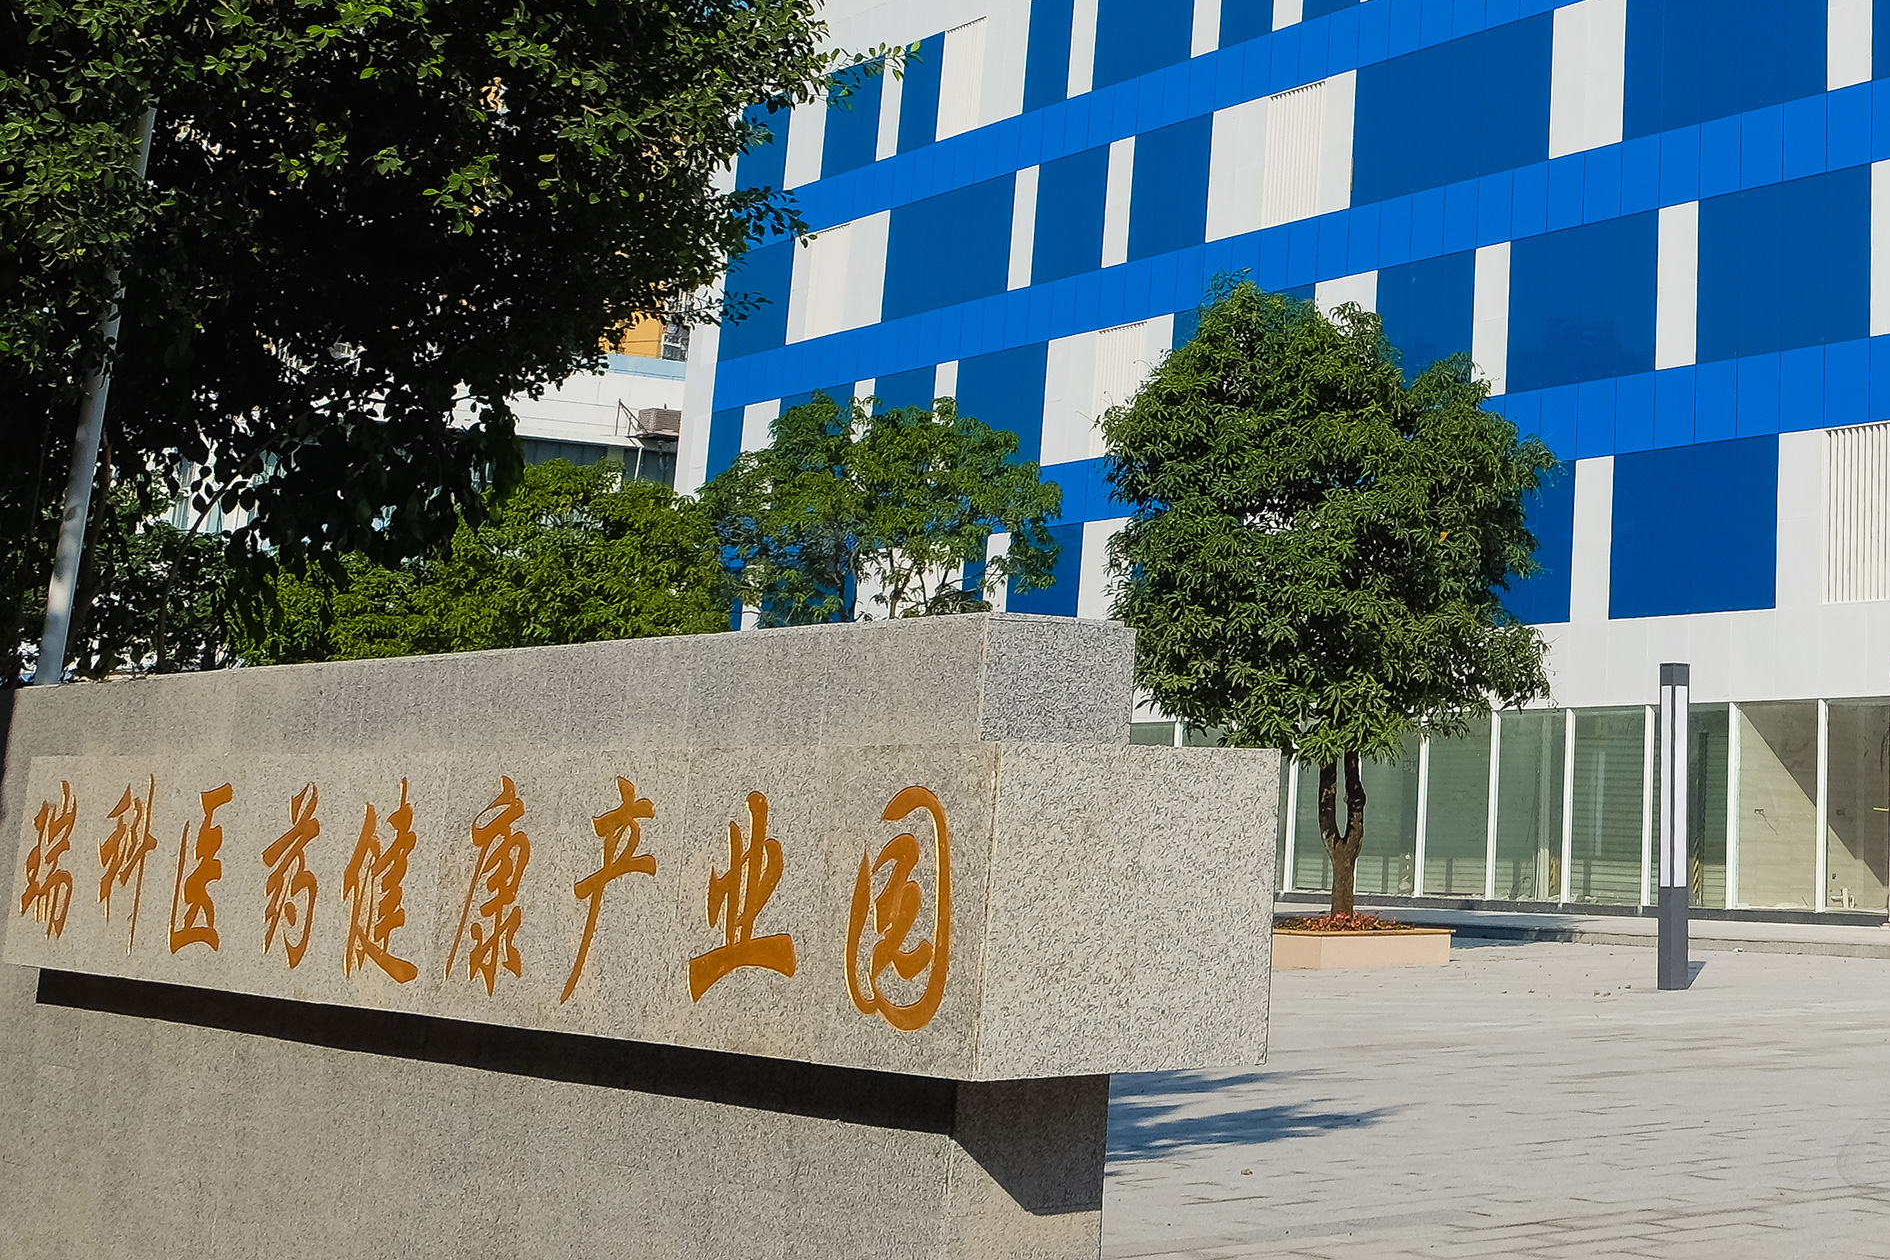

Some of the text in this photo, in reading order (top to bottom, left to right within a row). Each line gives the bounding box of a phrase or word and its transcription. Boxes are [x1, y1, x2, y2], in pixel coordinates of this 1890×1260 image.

[18, 773, 952, 1033] 瑞科医药健康产业园
